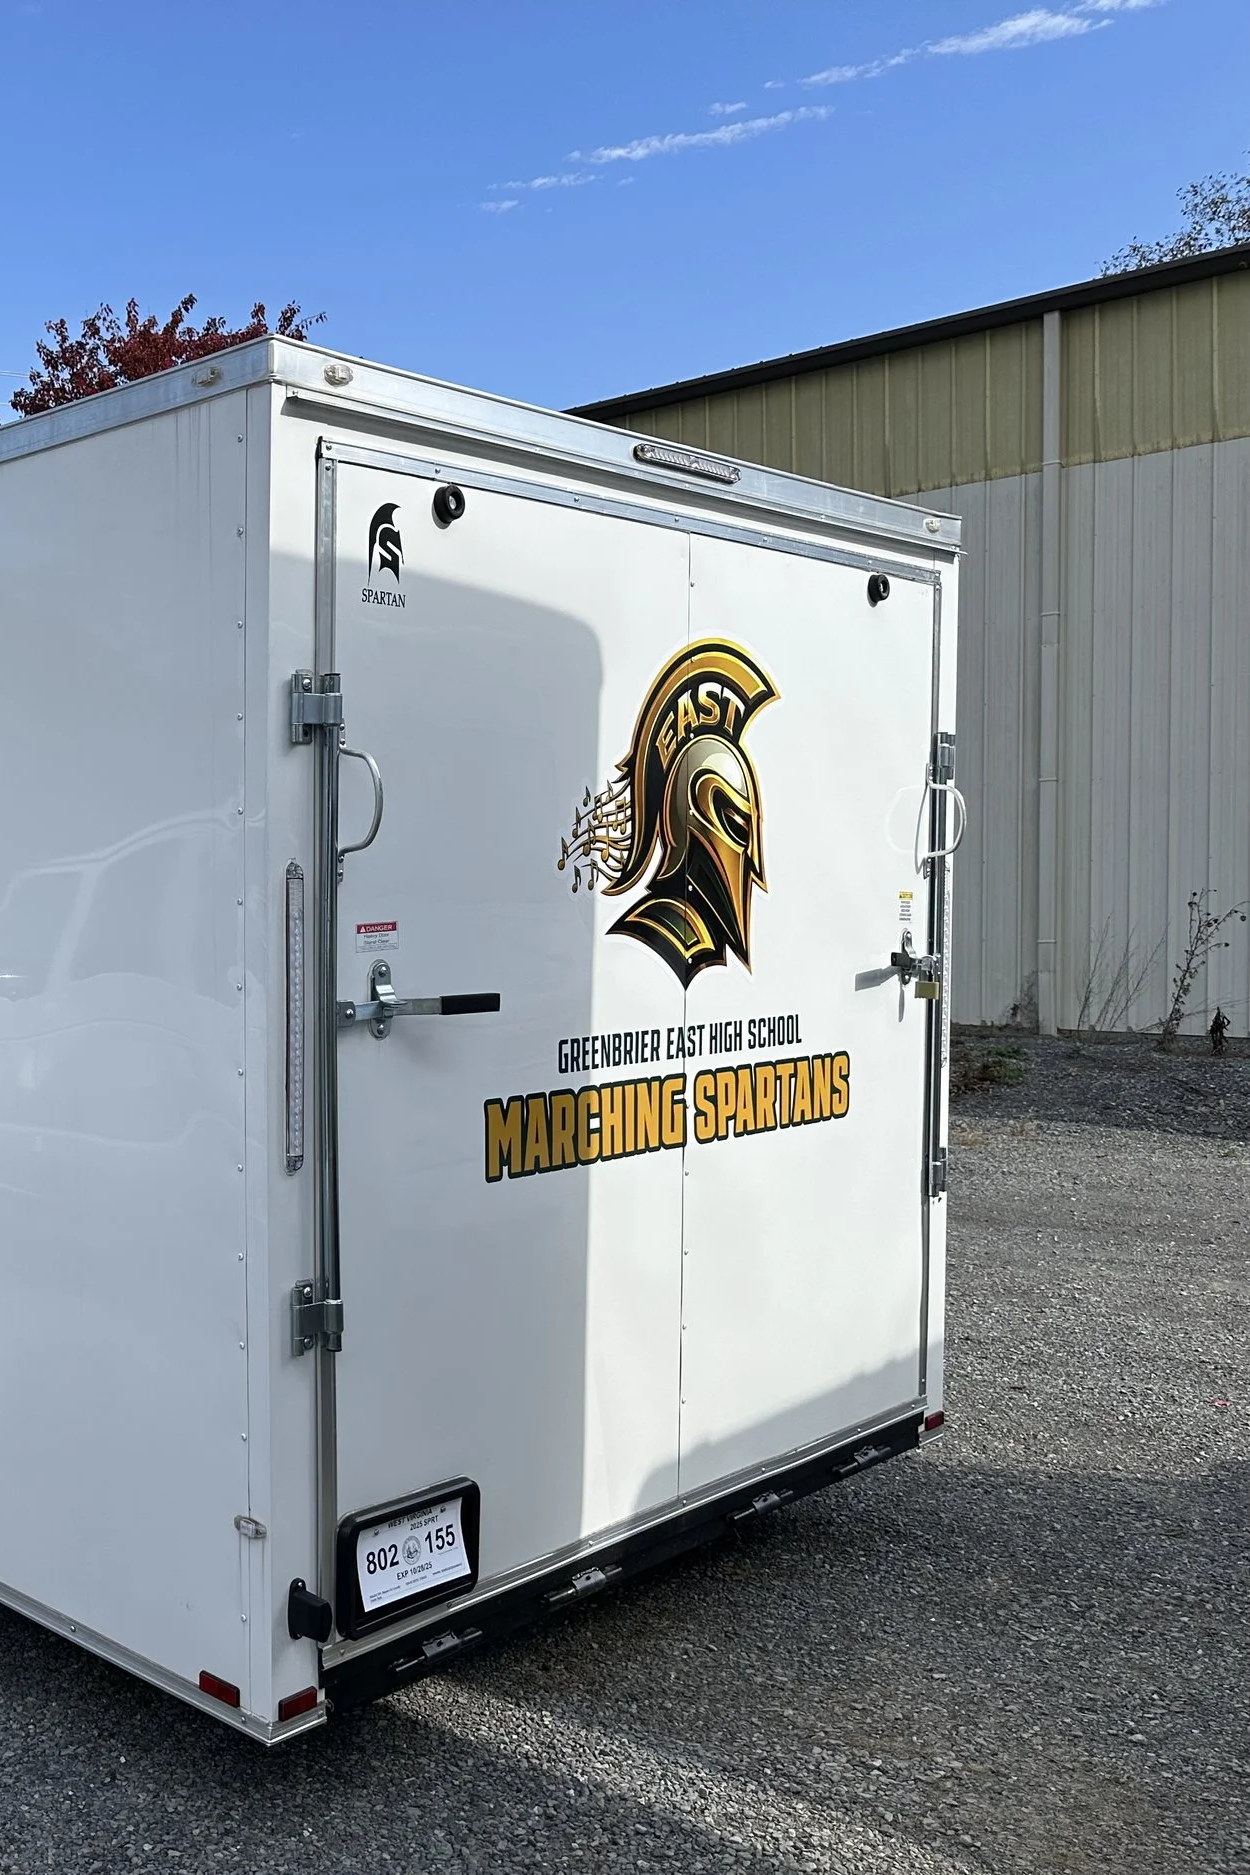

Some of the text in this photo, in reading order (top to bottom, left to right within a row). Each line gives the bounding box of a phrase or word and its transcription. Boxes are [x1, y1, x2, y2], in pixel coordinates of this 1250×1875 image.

[361, 588, 406, 608] SPARTAN
[655, 681, 746, 770] EAST
[366, 924, 393, 932] DANGER
[558, 1014, 802, 1074] GREENBRIER EAST HIGH SCHOOL
[484, 1050, 850, 1183] MARCHING SPARTANS
[387, 1507, 432, 1528] WEST VIRGINIA
[410, 1515, 438, 1531] 2025 SPRT
[366, 1523, 456, 1575] 802 155
[396, 1570, 409, 1580] EXP
